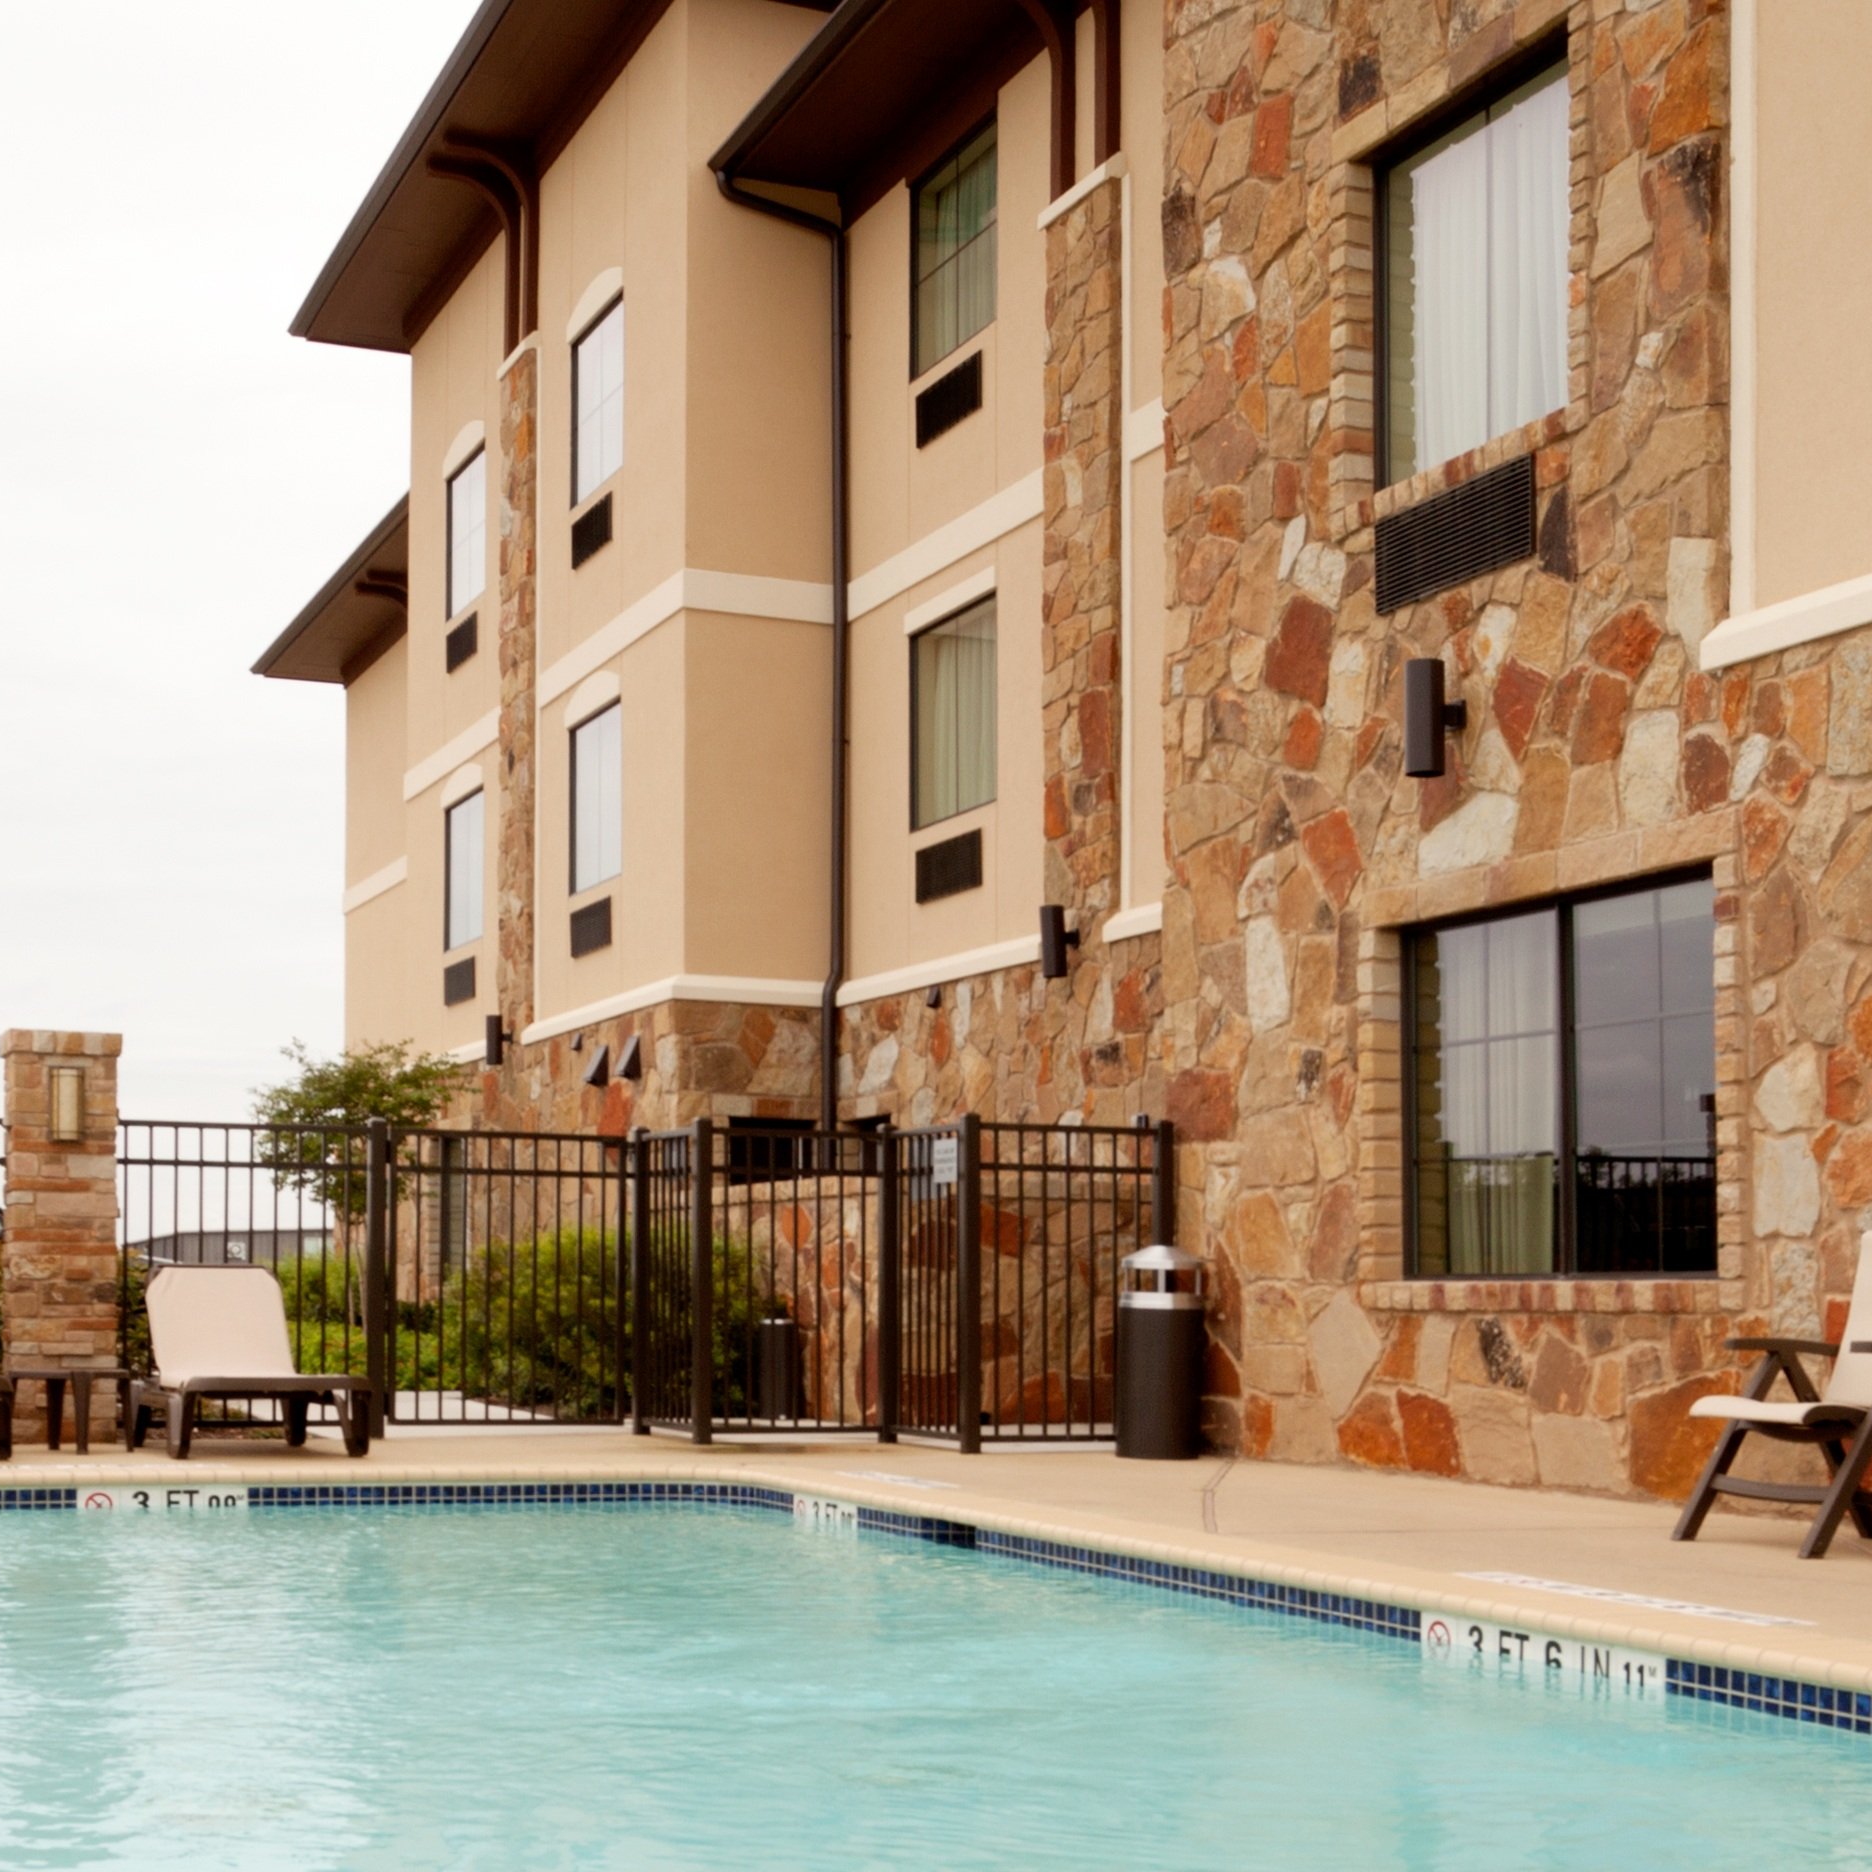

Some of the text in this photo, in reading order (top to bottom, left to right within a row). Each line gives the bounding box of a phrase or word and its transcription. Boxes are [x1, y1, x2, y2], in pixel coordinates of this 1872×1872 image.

[132, 1490, 149, 1508] 3
[166, 1490, 200, 1508] FT
[1468, 1625, 1483, 1652] 3
[1499, 1629, 1530, 1661] FT
[1544, 1640, 1562, 1669] 6
[1580, 1645, 1610, 1679] IN
